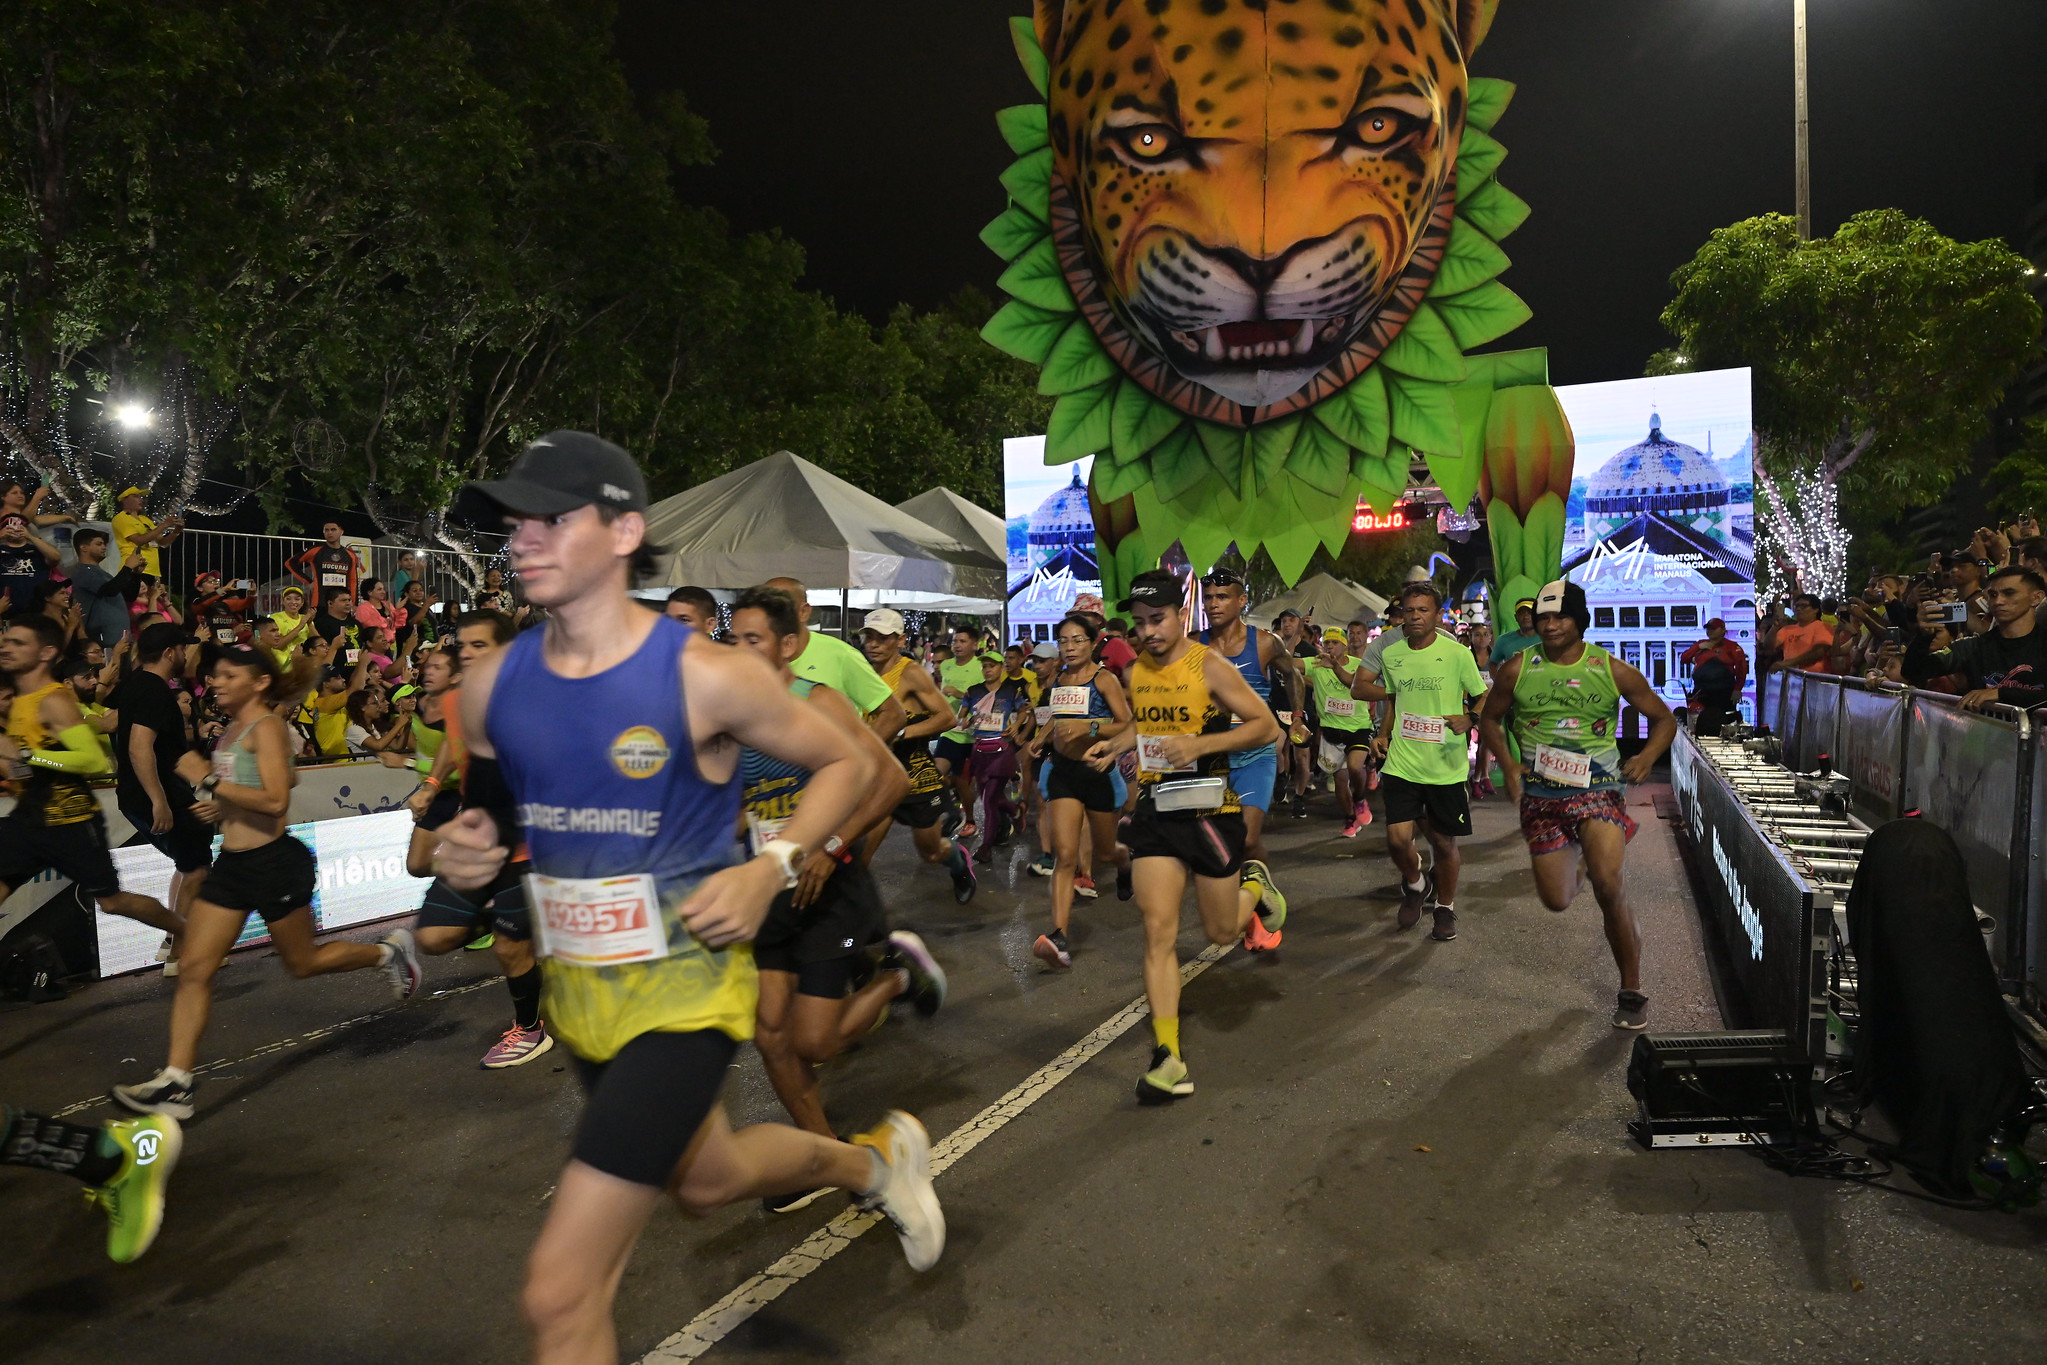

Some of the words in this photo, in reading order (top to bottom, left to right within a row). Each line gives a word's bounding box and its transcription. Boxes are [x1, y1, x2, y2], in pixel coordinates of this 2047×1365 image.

[1654, 553, 1703, 562] MARATONA
[1654, 560, 1725, 570] INTERNACIONAL
[1415, 677, 1445, 690] 42K
[1052, 694, 1084, 704] 43309
[1135, 706, 1190, 723] LION'S
[1404, 720, 1441, 733] 43835
[1541, 754, 1586, 775] 43098
[570, 808, 662, 837] MANAUS
[548, 901, 639, 932] 42957
